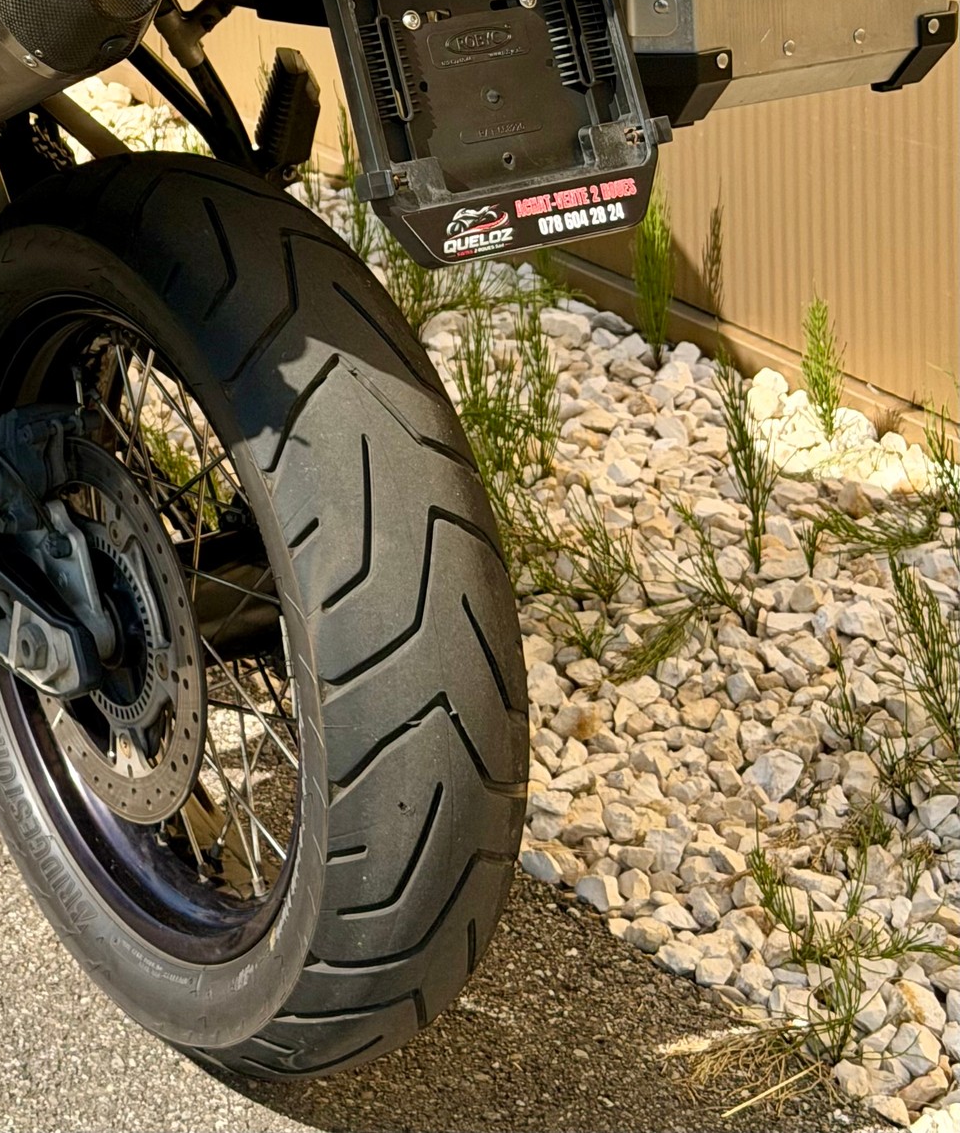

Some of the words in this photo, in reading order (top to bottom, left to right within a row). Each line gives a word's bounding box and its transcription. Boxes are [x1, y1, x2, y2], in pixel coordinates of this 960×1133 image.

[590, 185, 601, 203] 2
[600, 178, 637, 201] ROUES
[538, 214, 562, 235] 078
[565, 210, 589, 232] 604
[589, 205, 607, 225] 28
[607, 202, 625, 221] 24
[443, 227, 514, 254] QUELOZ
